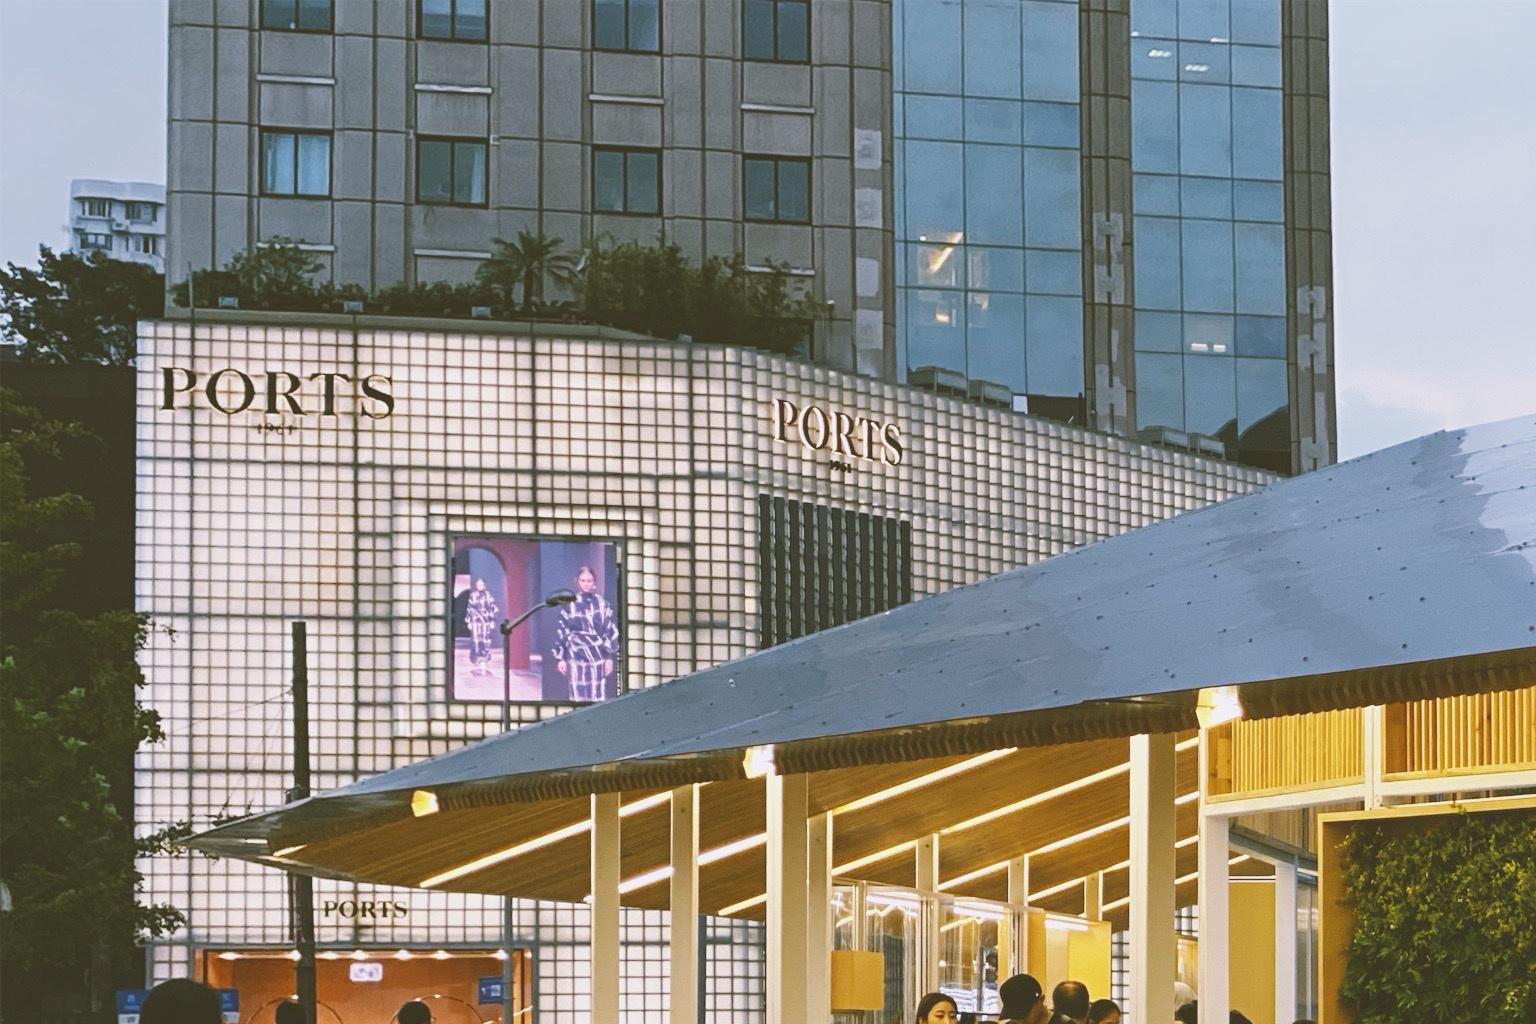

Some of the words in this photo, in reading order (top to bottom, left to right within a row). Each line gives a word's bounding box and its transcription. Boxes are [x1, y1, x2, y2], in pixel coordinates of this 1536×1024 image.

[160, 367, 395, 419] PORTS
[773, 398, 903, 467] PORTS
[324, 900, 408, 919] PORTS
